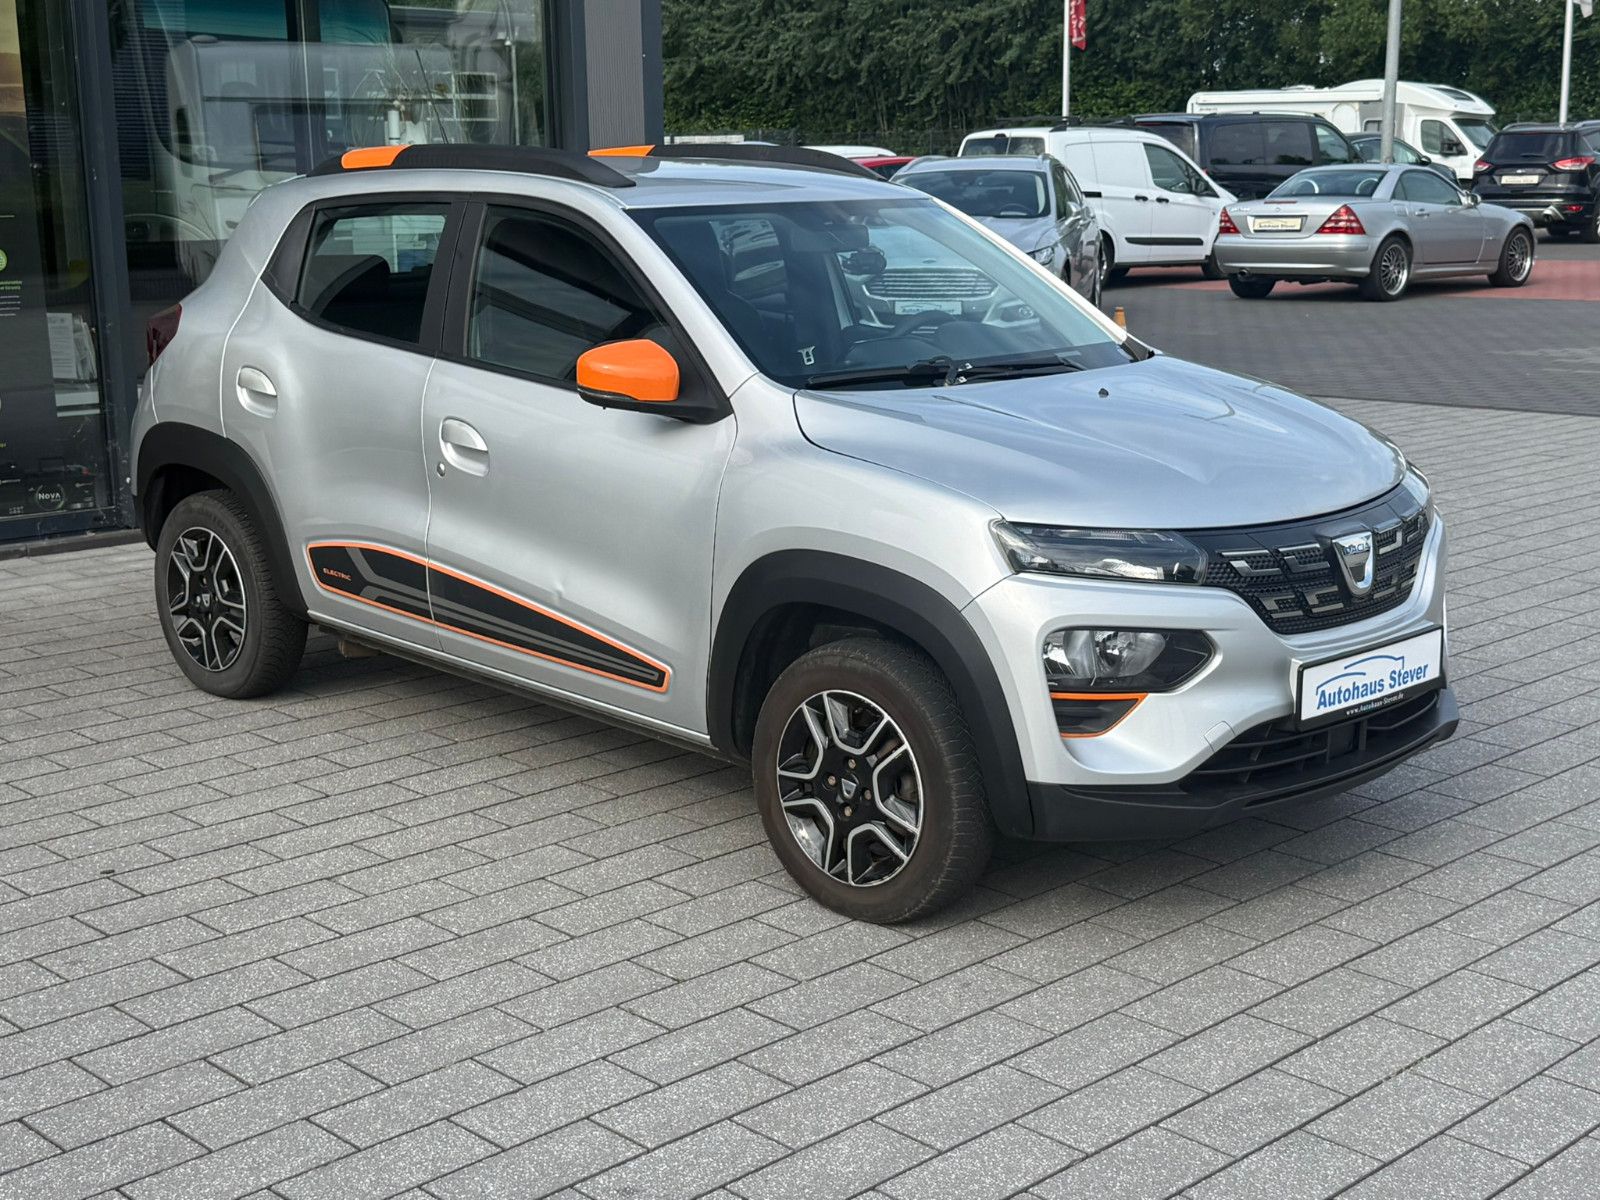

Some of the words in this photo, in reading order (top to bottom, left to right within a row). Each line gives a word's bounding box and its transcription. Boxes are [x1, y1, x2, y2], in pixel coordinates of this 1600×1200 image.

[323, 567, 351, 581] ELECTRIC
[1316, 678, 1385, 710] Autohaus
[1388, 663, 1429, 689] Stever
